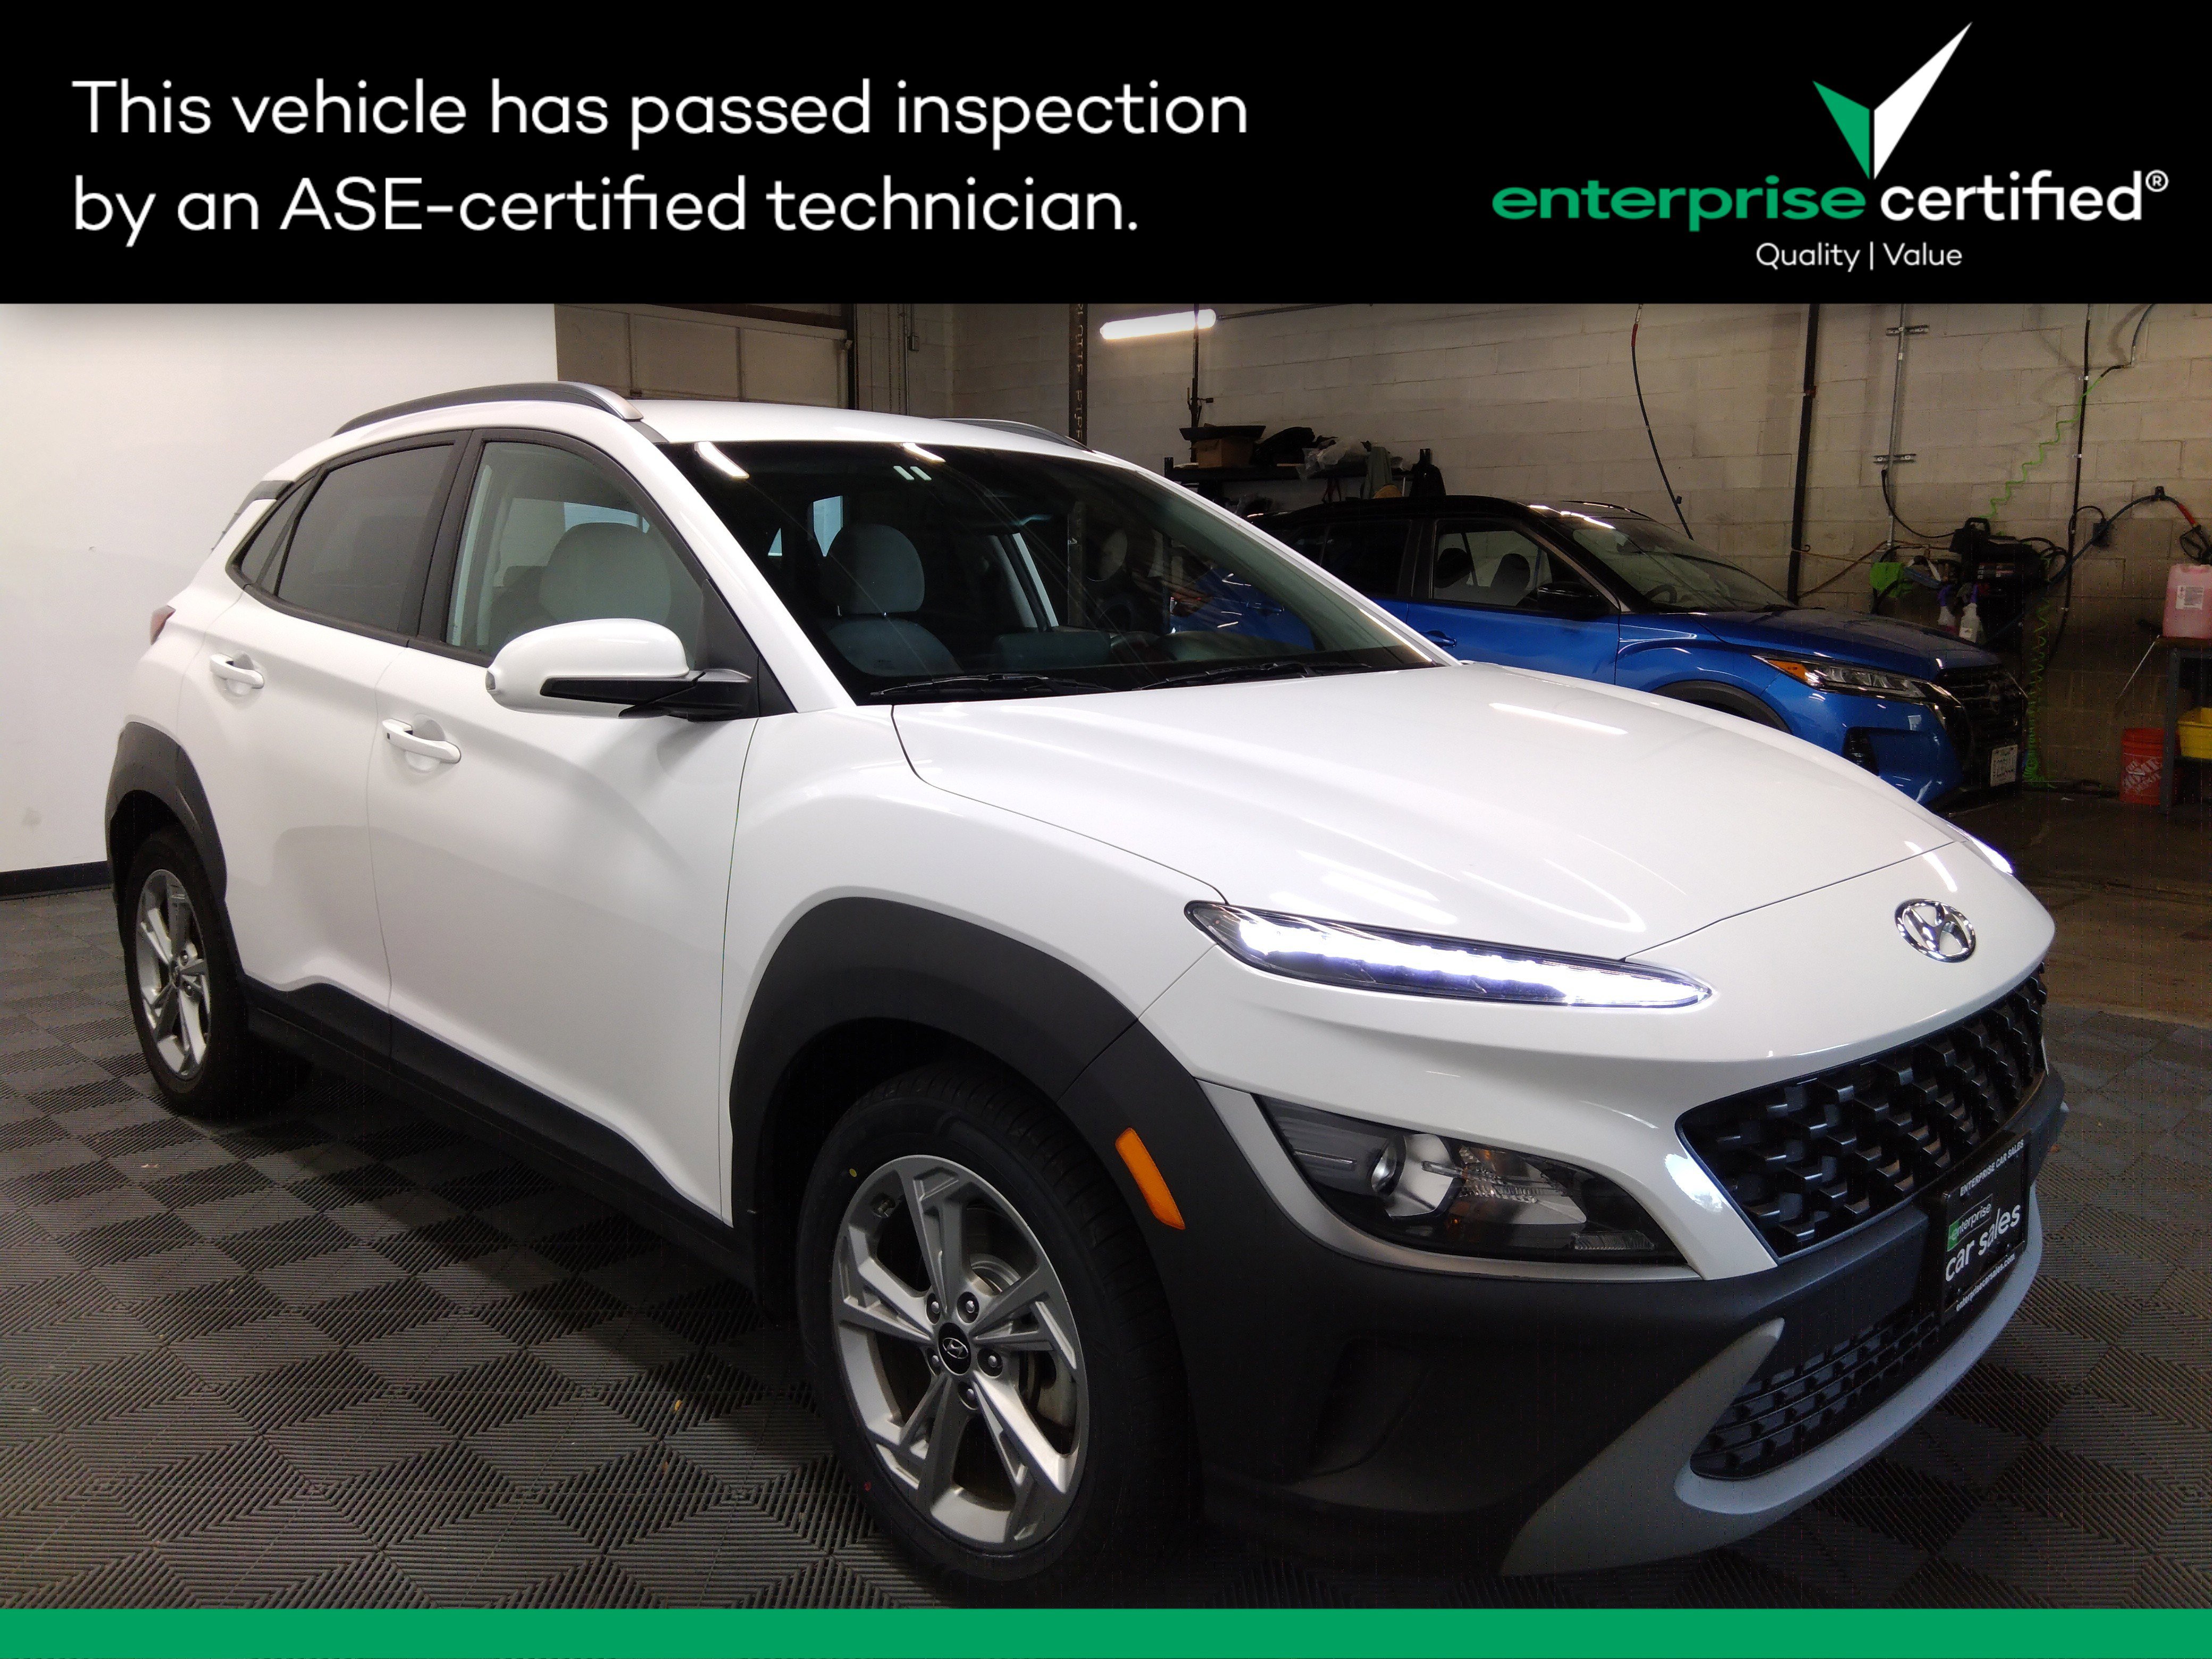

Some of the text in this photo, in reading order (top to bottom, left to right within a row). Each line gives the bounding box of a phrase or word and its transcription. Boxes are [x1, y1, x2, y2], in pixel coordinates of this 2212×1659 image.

[1960, 1139, 2024, 1196] ENTERPRISE CAR SALES
[1945, 1204, 2021, 1282] car sales
[1949, 1203, 1991, 1241] enterprise
